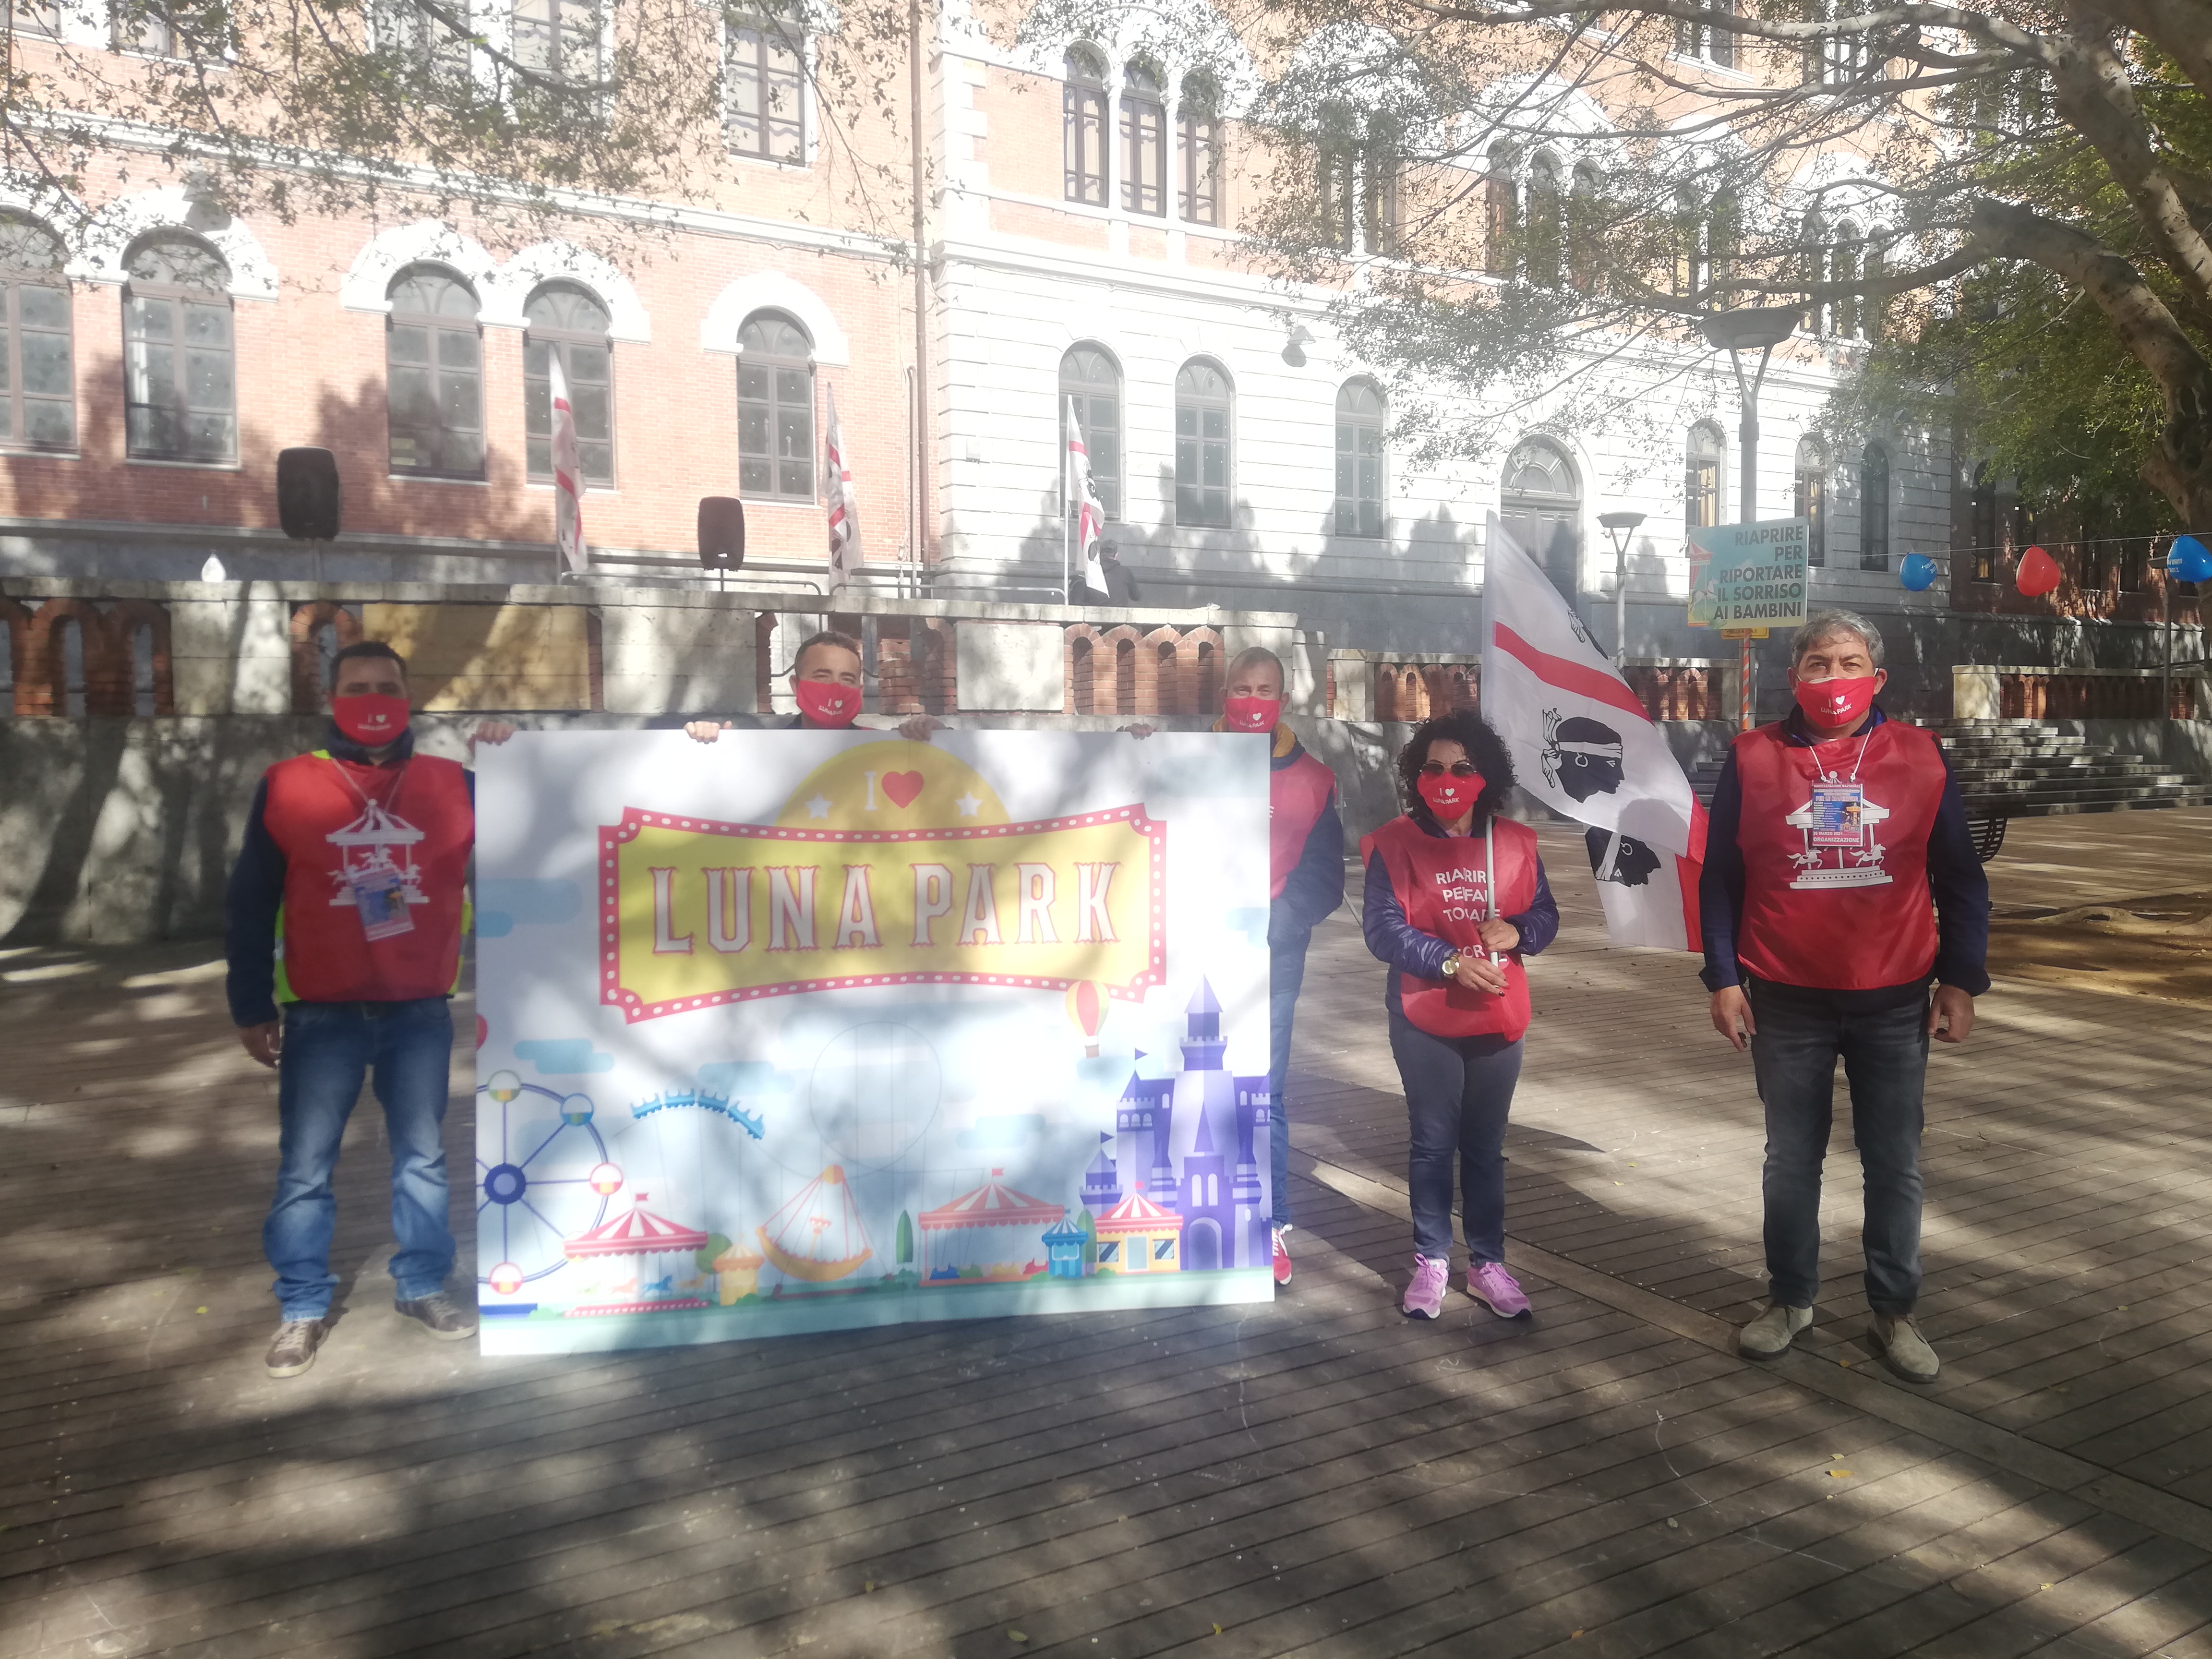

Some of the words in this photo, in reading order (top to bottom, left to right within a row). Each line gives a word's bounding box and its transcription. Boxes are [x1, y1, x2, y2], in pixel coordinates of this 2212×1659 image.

[1735, 525, 1803, 545] RIAPRIRE
[1775, 545, 1803, 561] PER
[1720, 564, 1802, 583] RIPORTARE
[1718, 587, 1728, 601] IL
[1733, 583, 1802, 601] SORRISO
[1713, 605, 1728, 620] AI
[1733, 601, 1801, 619] BAMBINI
[1821, 707, 1837, 715] LUNA
[1837, 703, 1851, 714] PARK
[1828, 698, 1831, 707] I
[865, 771, 878, 810] I
[1439, 788, 1443, 796] I
[1435, 867, 1495, 884] RIARIR
[648, 864, 884, 955] LUNA
[909, 862, 1121, 947] PARK
